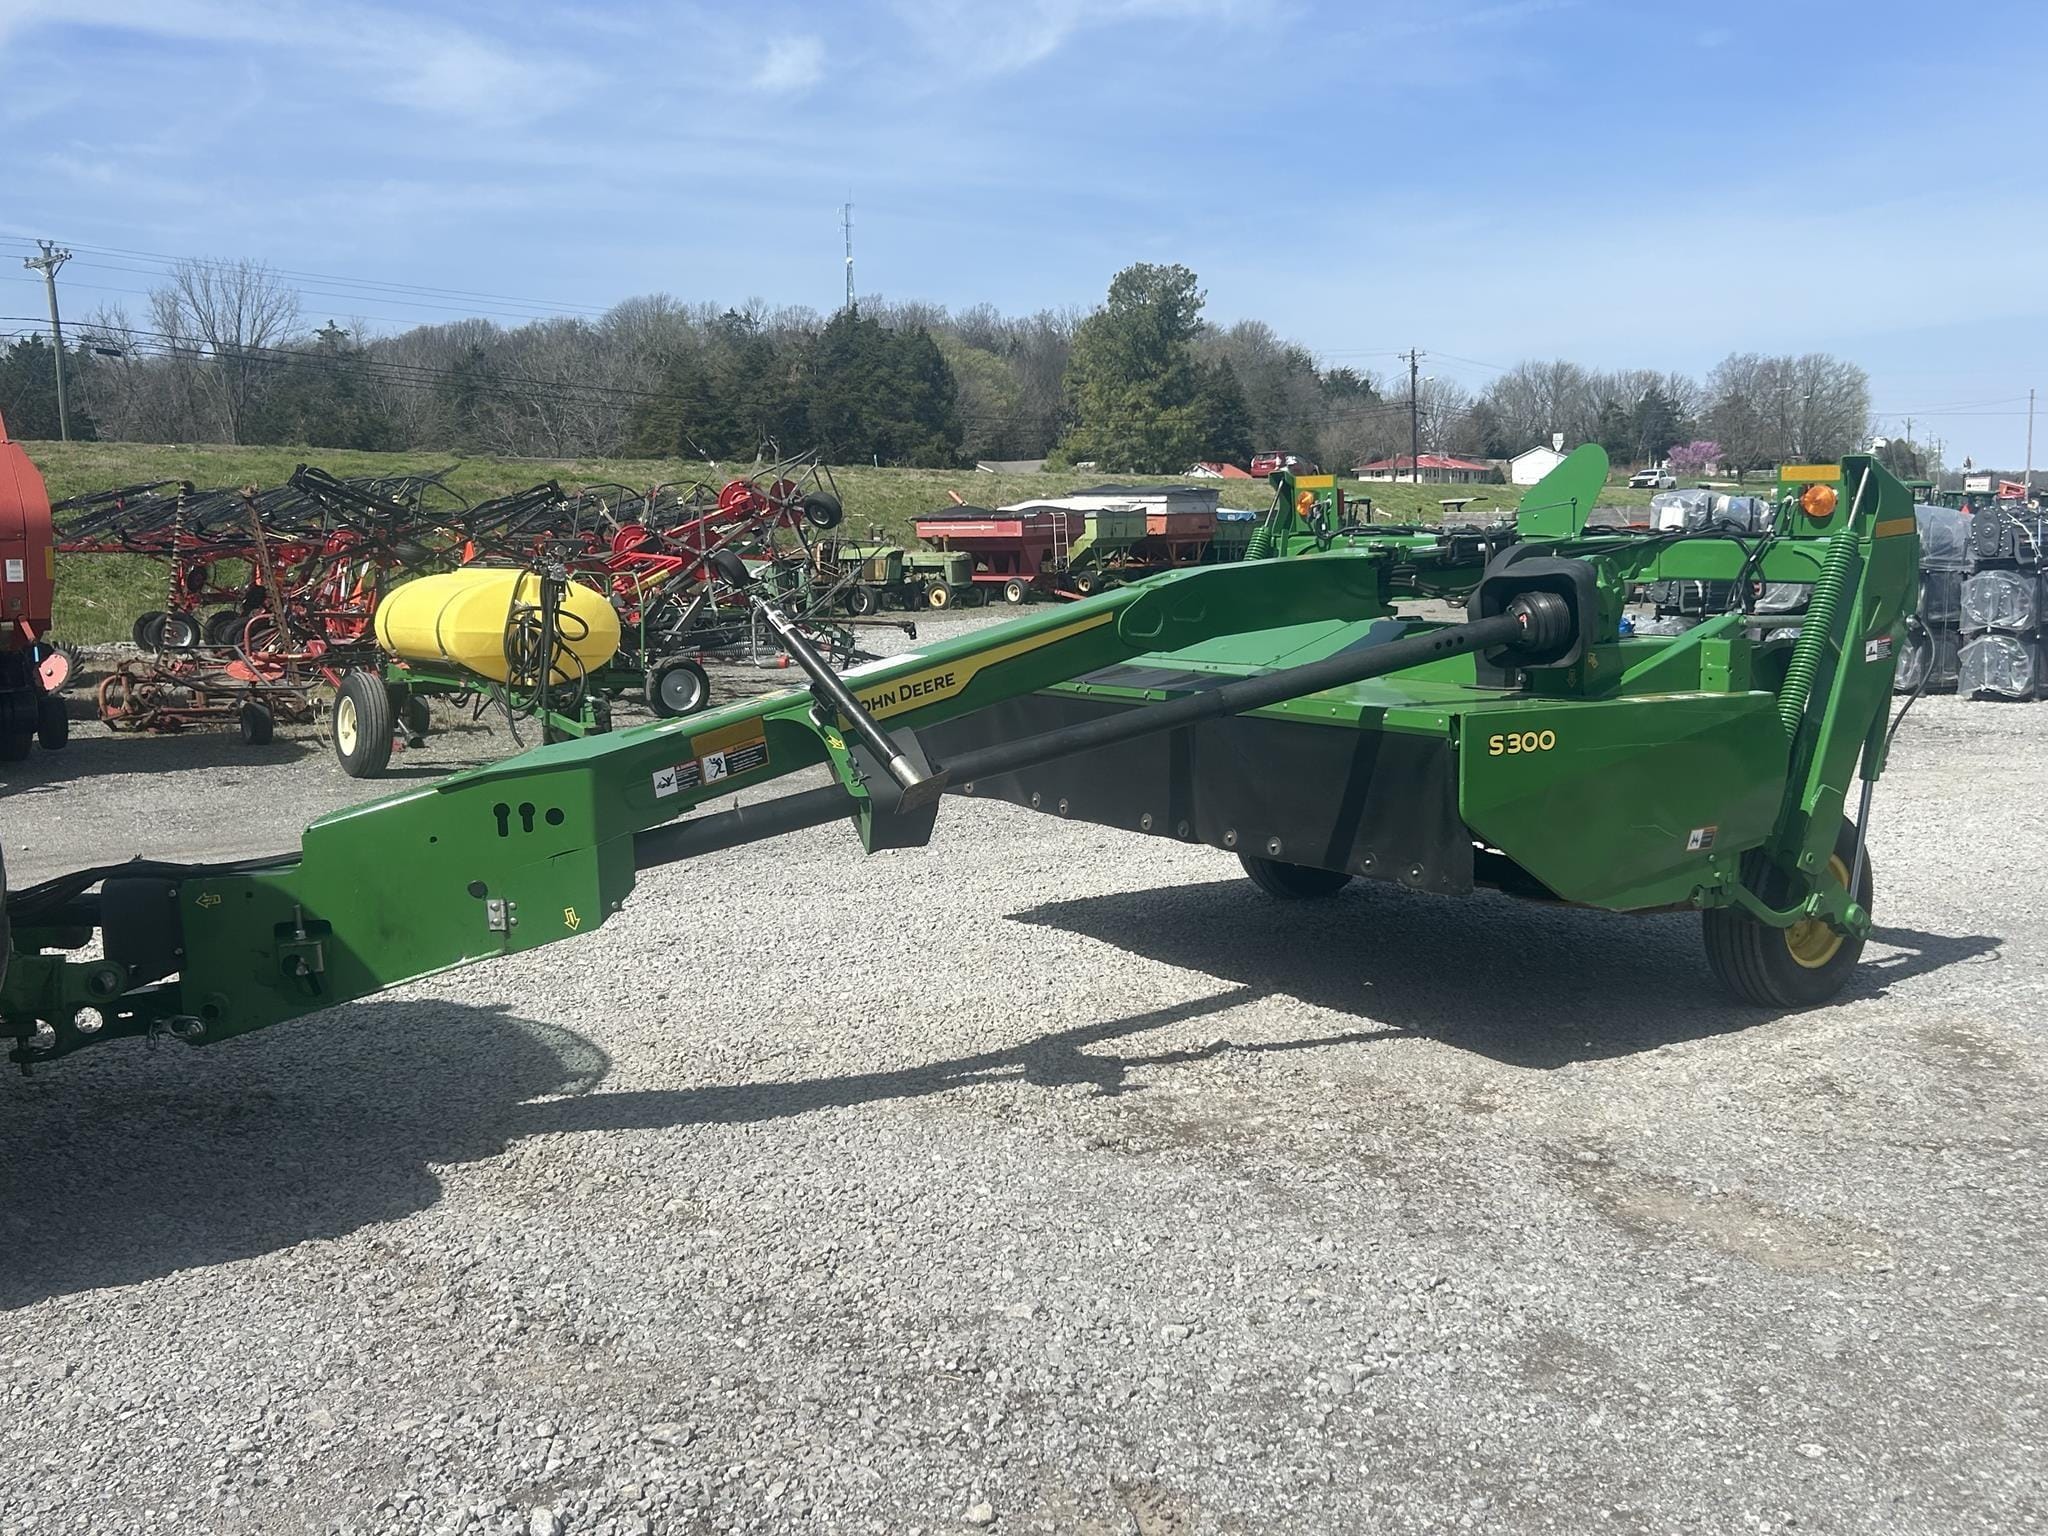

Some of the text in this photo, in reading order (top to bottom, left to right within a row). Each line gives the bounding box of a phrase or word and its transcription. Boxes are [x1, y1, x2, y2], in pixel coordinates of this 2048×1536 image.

[860, 673, 956, 713] OHN DEERE
[1489, 730, 1556, 756] S300
